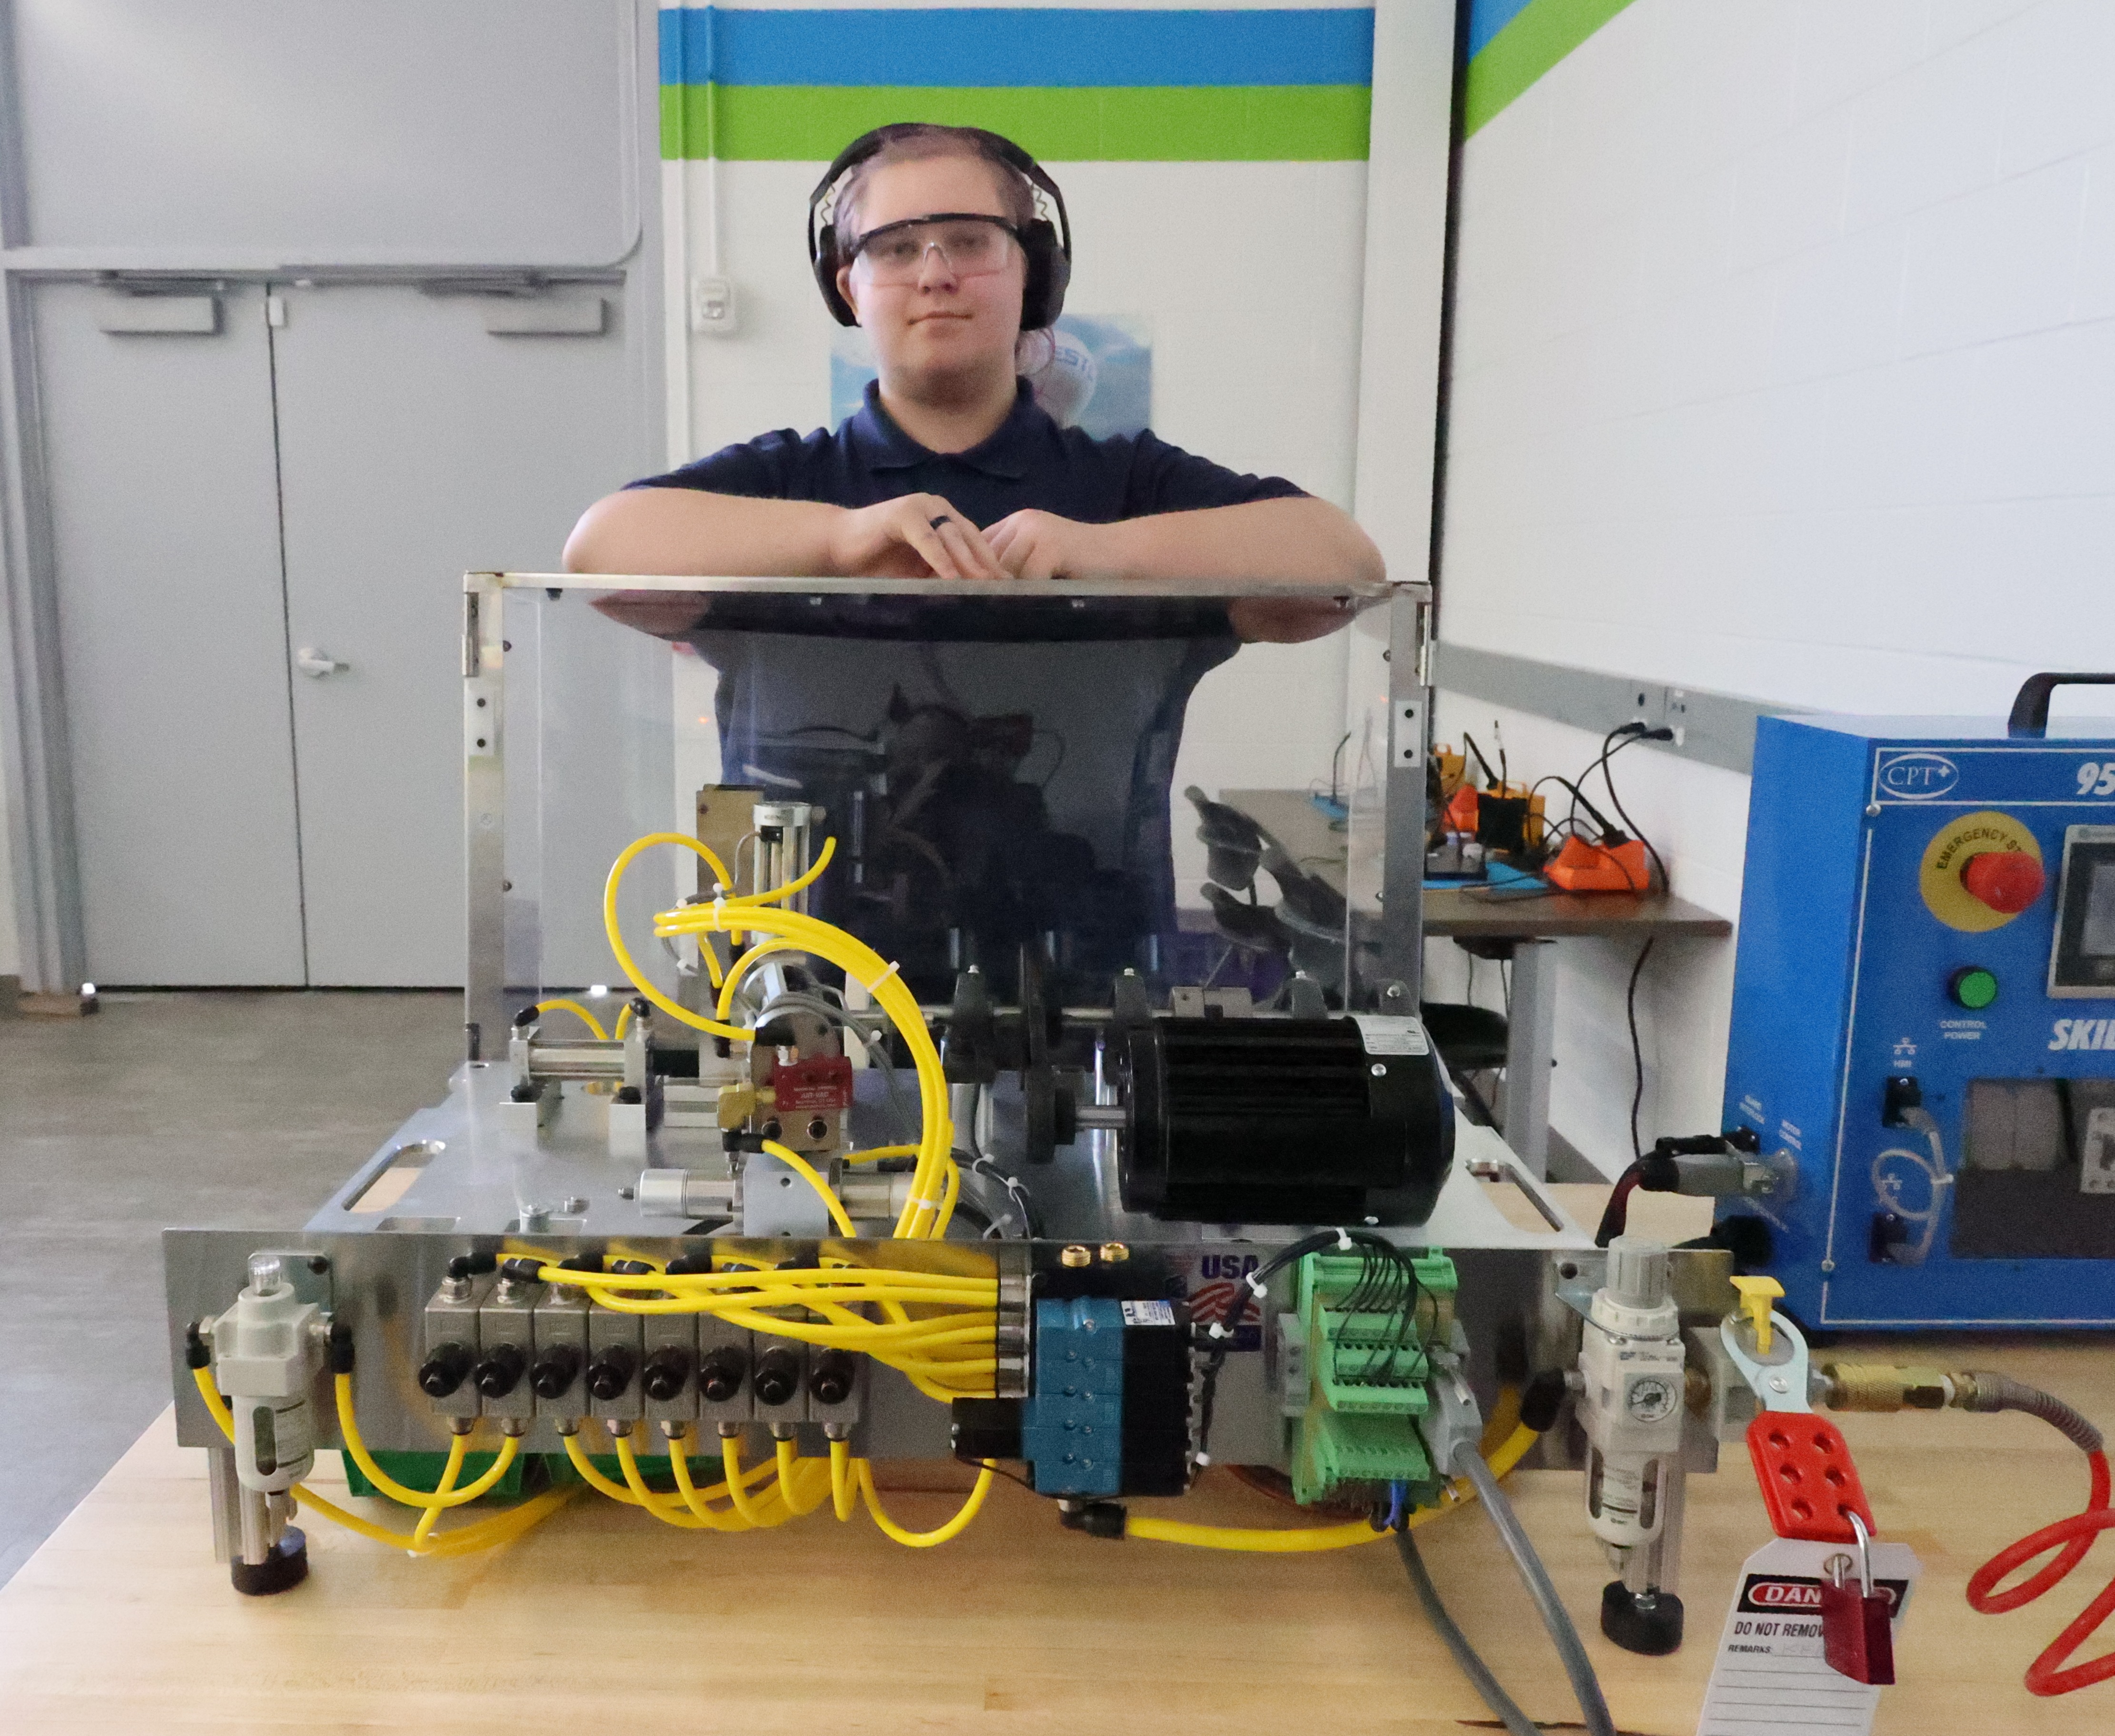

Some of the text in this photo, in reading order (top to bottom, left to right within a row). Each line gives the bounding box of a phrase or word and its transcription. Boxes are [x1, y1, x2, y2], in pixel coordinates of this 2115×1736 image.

[1888, 767, 1936, 785] CPT
[1936, 828, 2022, 869] EMERGENCY ST
[1939, 1020, 1987, 1029] CONTROL
[1944, 1031, 1980, 1040] POWER
[1202, 1254, 1259, 1279] USA
[1765, 1586, 1822, 1603] DAN
[1734, 1621, 1824, 1638] DO NOT REMOV
